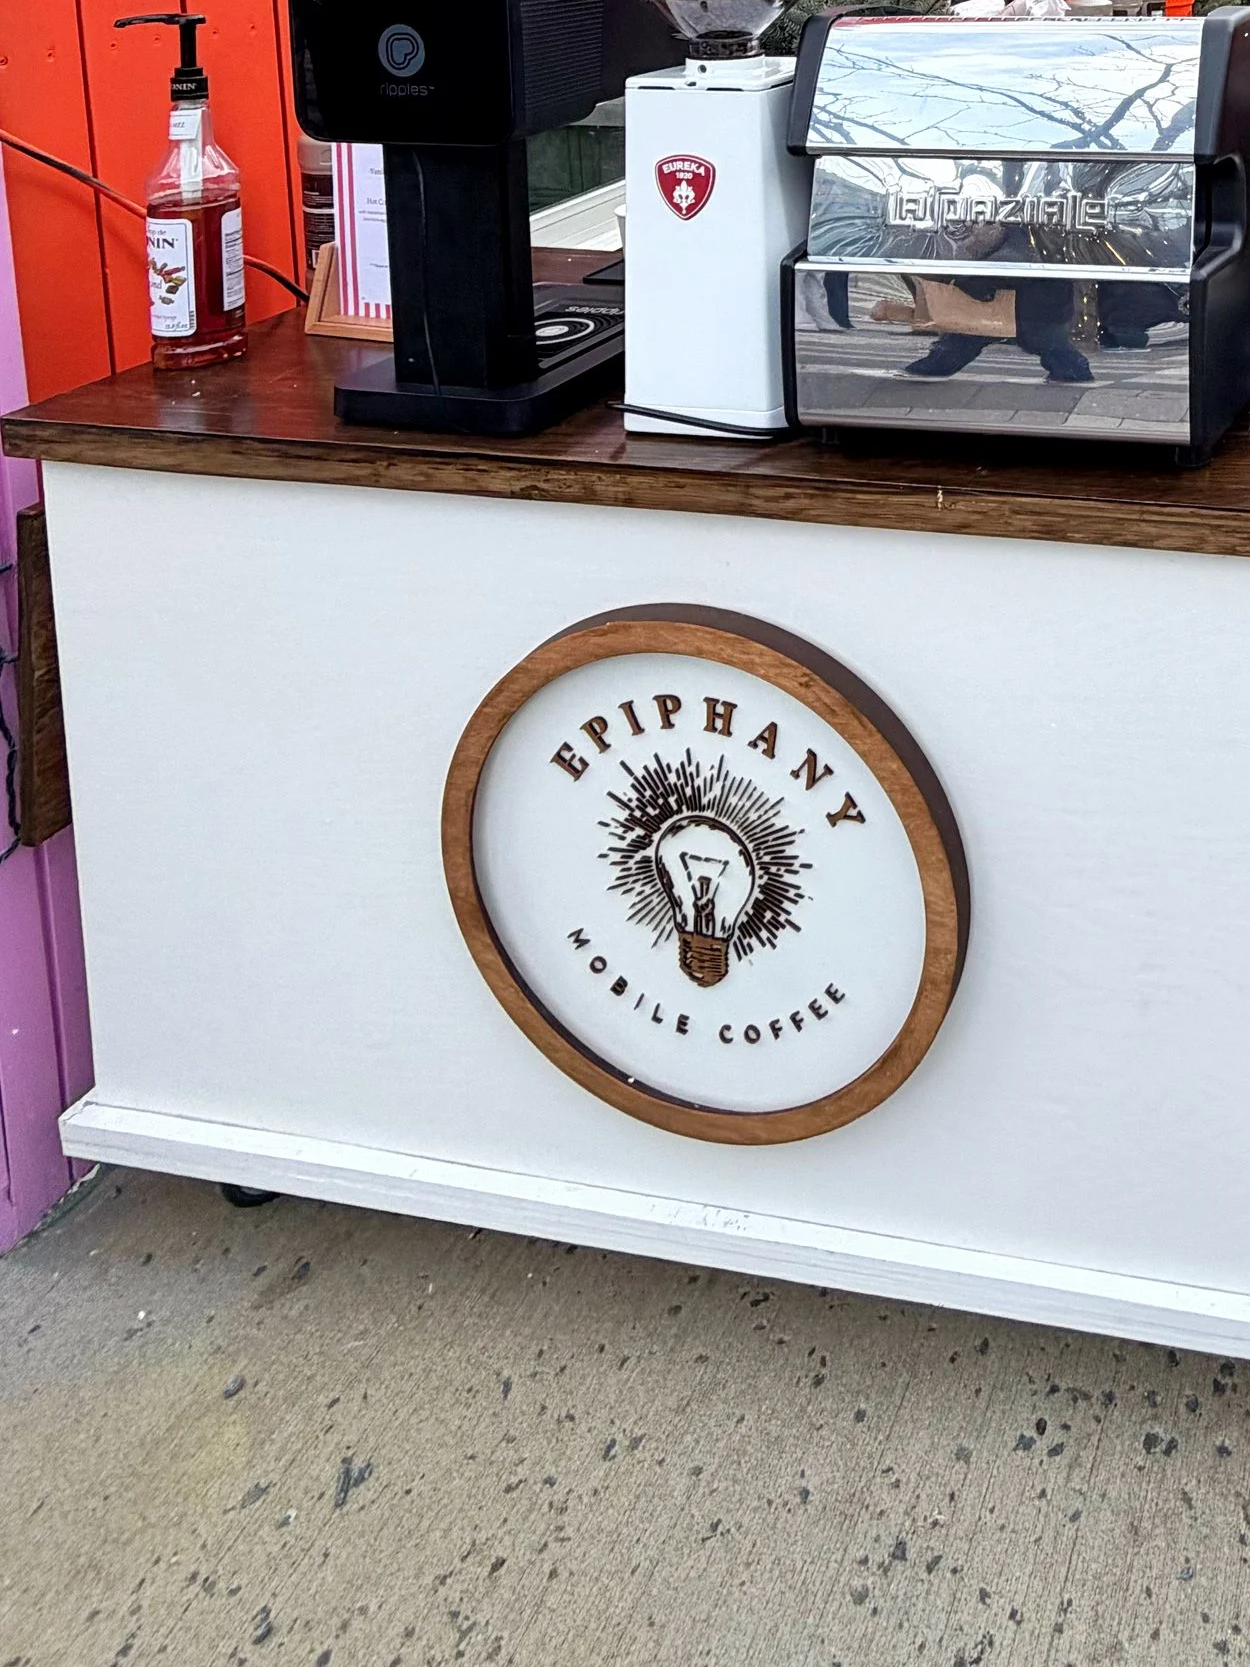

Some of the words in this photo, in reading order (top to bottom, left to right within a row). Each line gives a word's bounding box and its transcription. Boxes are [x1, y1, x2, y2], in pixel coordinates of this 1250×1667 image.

[662, 161, 705, 177] EUREKA
[549, 693, 866, 828] EPIPHANY
[567, 927, 690, 1036] MOBILE
[719, 982, 846, 1045] COFFEE
